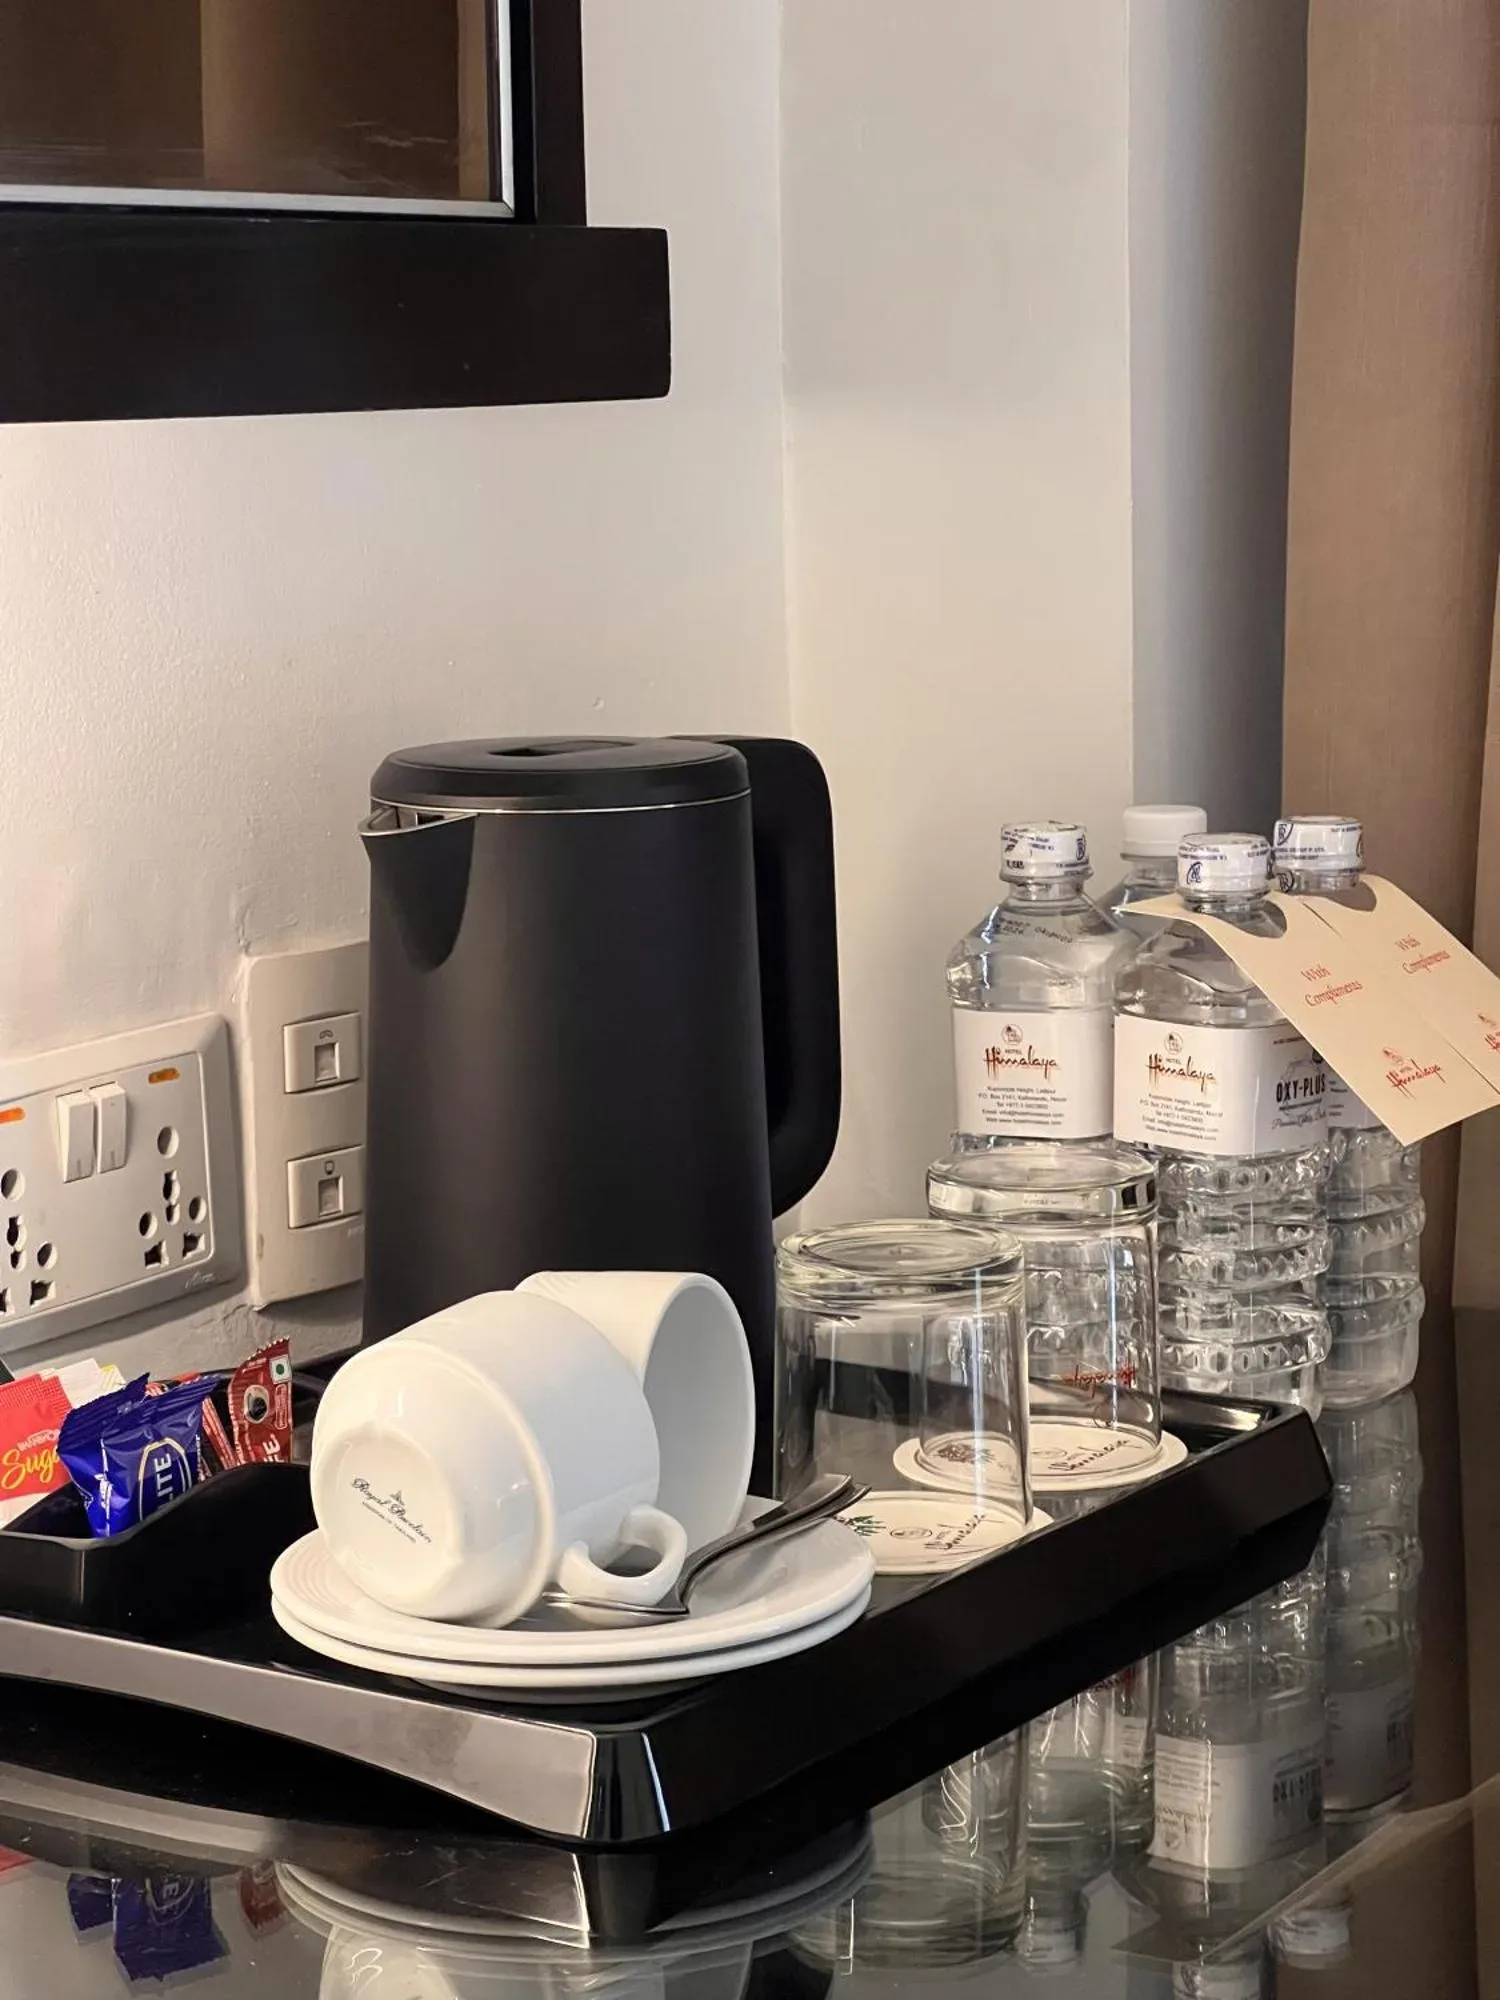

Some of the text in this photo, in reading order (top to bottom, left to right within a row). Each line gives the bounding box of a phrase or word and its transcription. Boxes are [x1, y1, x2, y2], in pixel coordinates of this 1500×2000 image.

[1300, 964, 1331, 982] With
[1304, 980, 1364, 1006] Compliments
[983, 1045, 1058, 1079] Himalaya
[1146, 1053, 1217, 1092] Himalaya
[1276, 1073, 1325, 1102] OXY-PLUS
[153, 1453, 174, 1500] ITE
